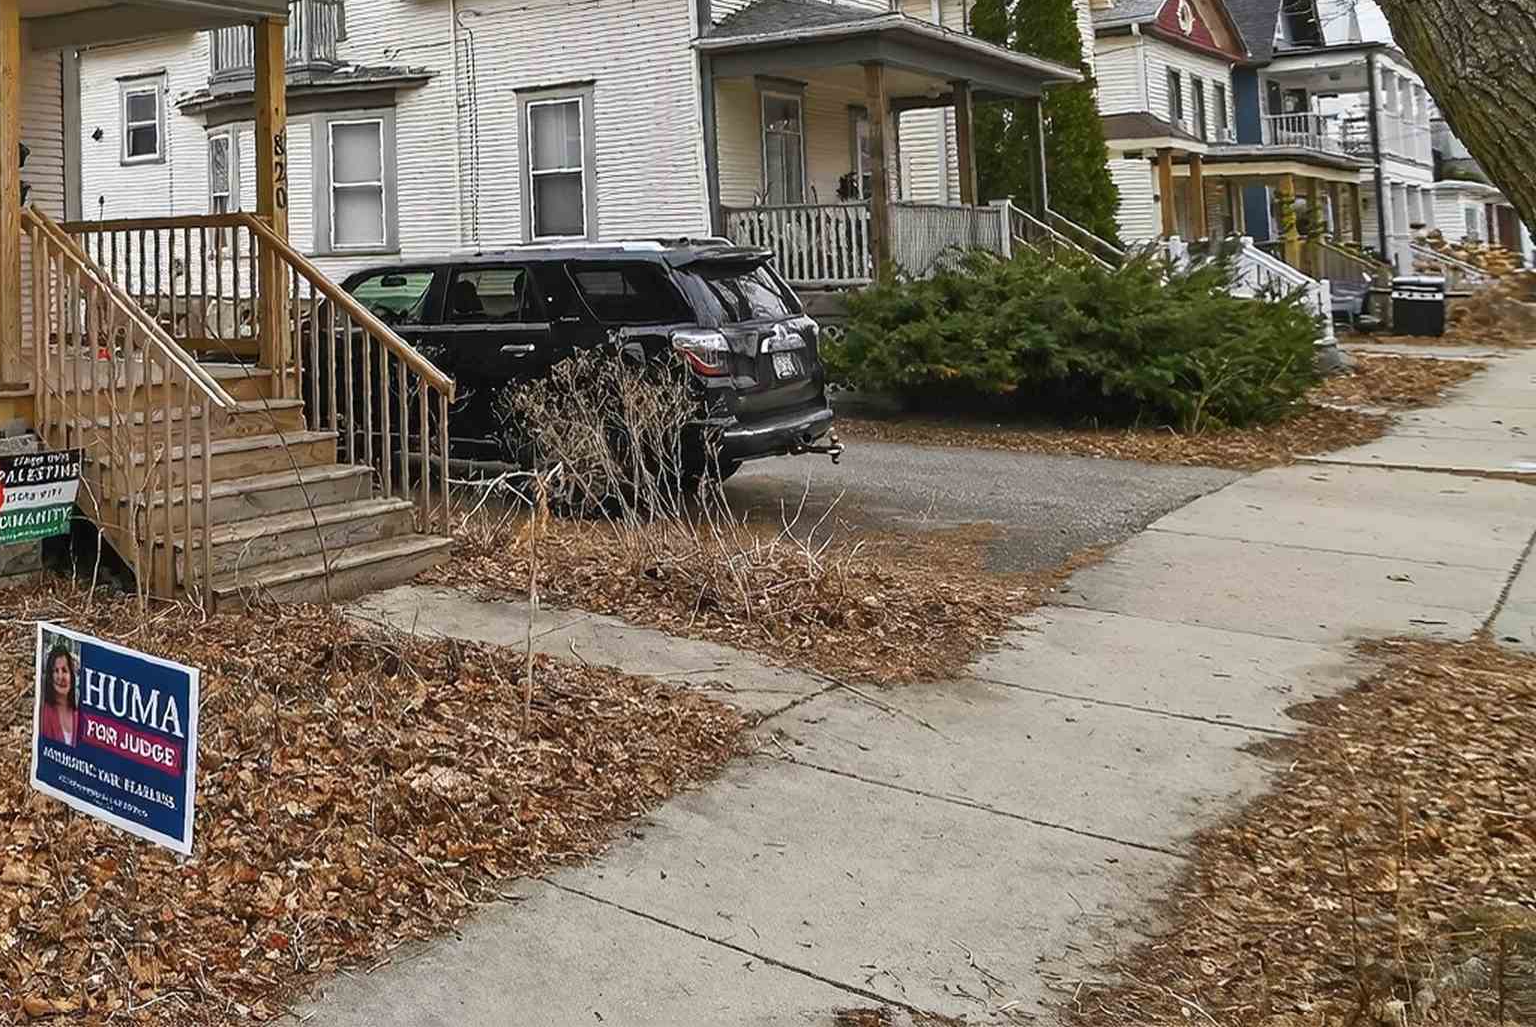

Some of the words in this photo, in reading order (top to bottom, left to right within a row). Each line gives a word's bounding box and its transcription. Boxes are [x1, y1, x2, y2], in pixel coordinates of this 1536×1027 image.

[273, 134, 287, 210] 820
[82, 667, 185, 738] HUMA
[87, 720, 117, 747] FOR
[120, 733, 175, 766] JUDGE
